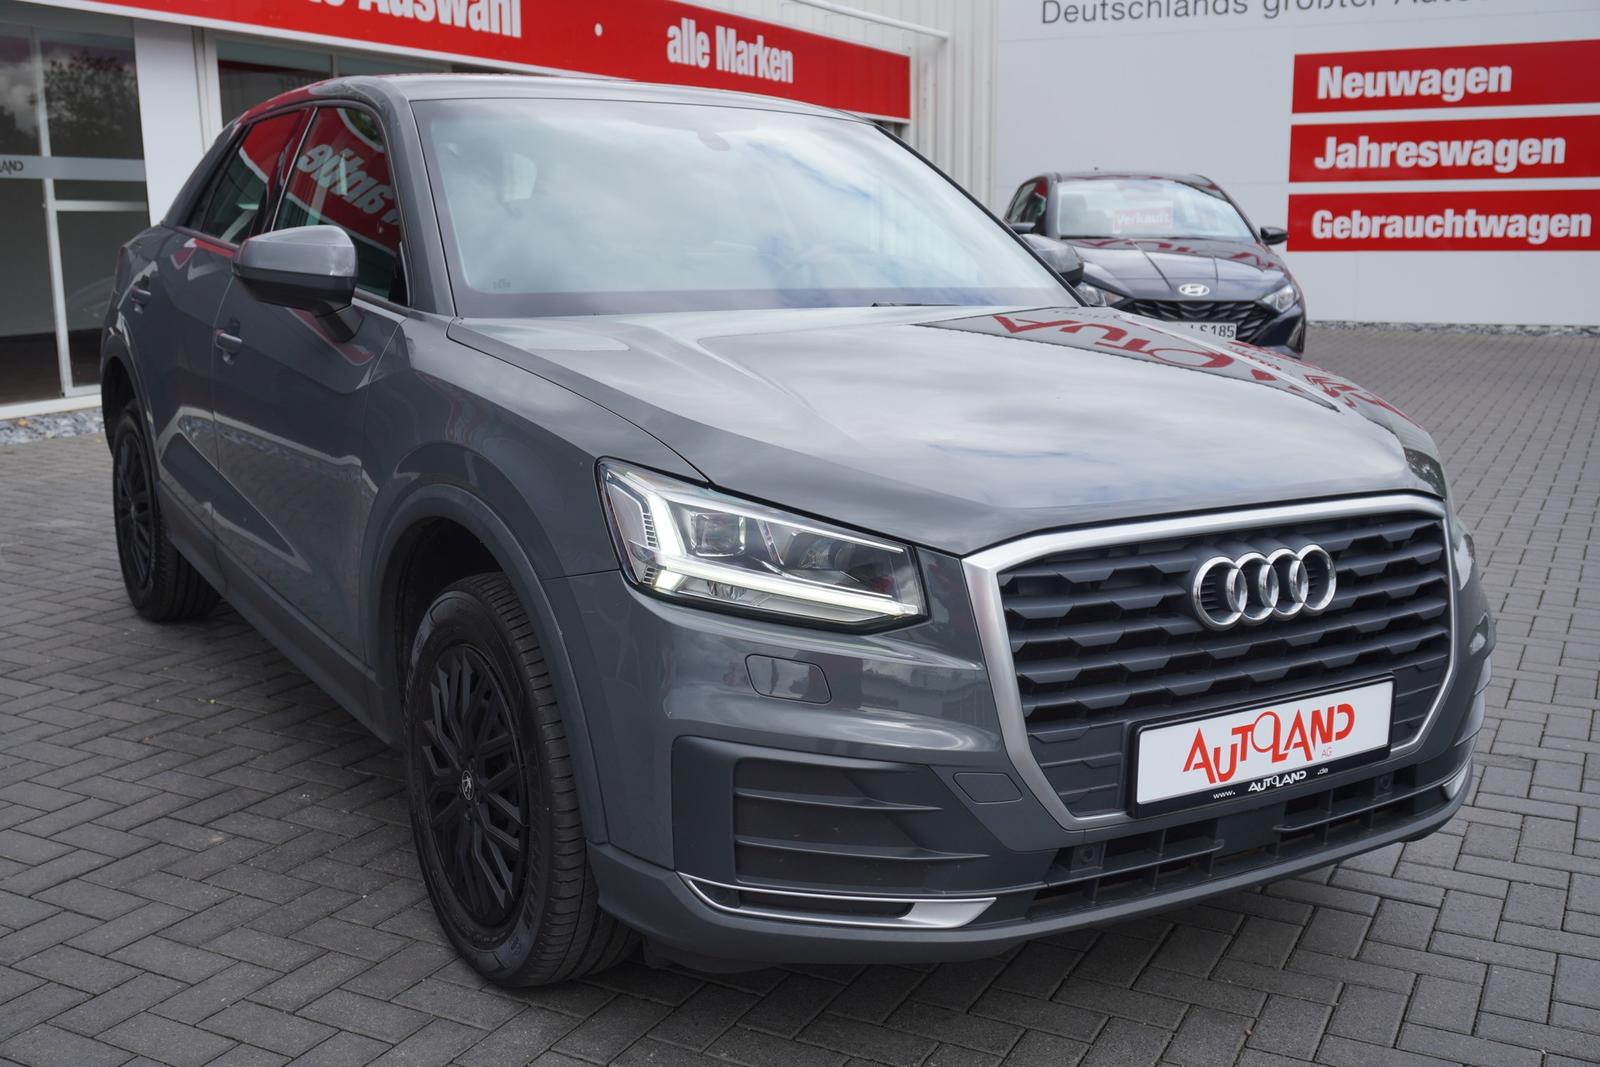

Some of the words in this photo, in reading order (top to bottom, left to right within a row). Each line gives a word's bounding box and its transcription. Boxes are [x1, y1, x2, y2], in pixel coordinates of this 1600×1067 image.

[359, 0, 522, 38] swahl
[1042, 0, 1249, 24] Deutschlands
[667, 18, 711, 65] alle
[715, 26, 794, 84] Marken
[1317, 65, 1512, 102] Neuwagen
[1314, 135, 1566, 173] Jahreswagen
[1311, 208, 1592, 245] Gebrauchtwagen
[1211, 324, 1236, 338] 185
[1183, 703, 1355, 784] AUTOLAND
[1213, 790, 1236, 800] www.
[1317, 766, 1329, 776] .de
